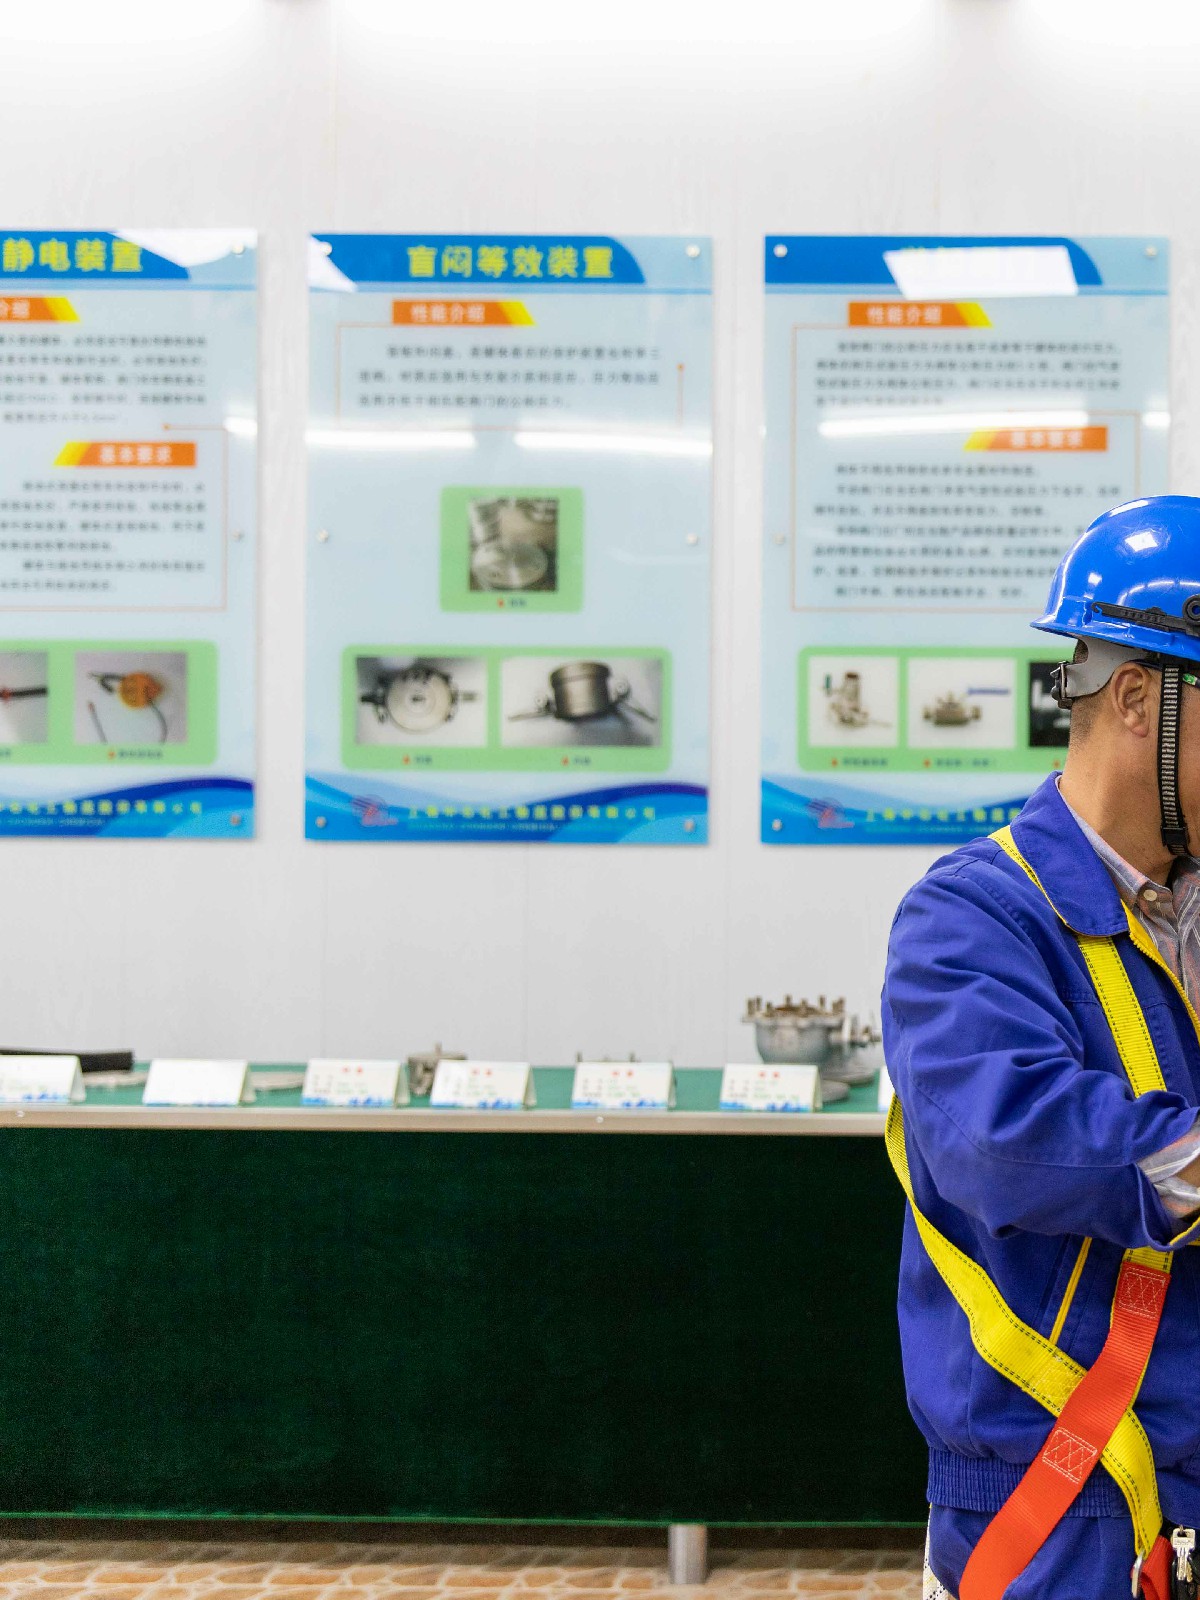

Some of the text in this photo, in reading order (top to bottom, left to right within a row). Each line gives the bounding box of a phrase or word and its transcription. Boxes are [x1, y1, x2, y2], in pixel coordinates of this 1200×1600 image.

[3, 237, 143, 272] 静电装置
[411, 303, 486, 322] 性能介绍
[866, 304, 941, 324] 性能介绍
